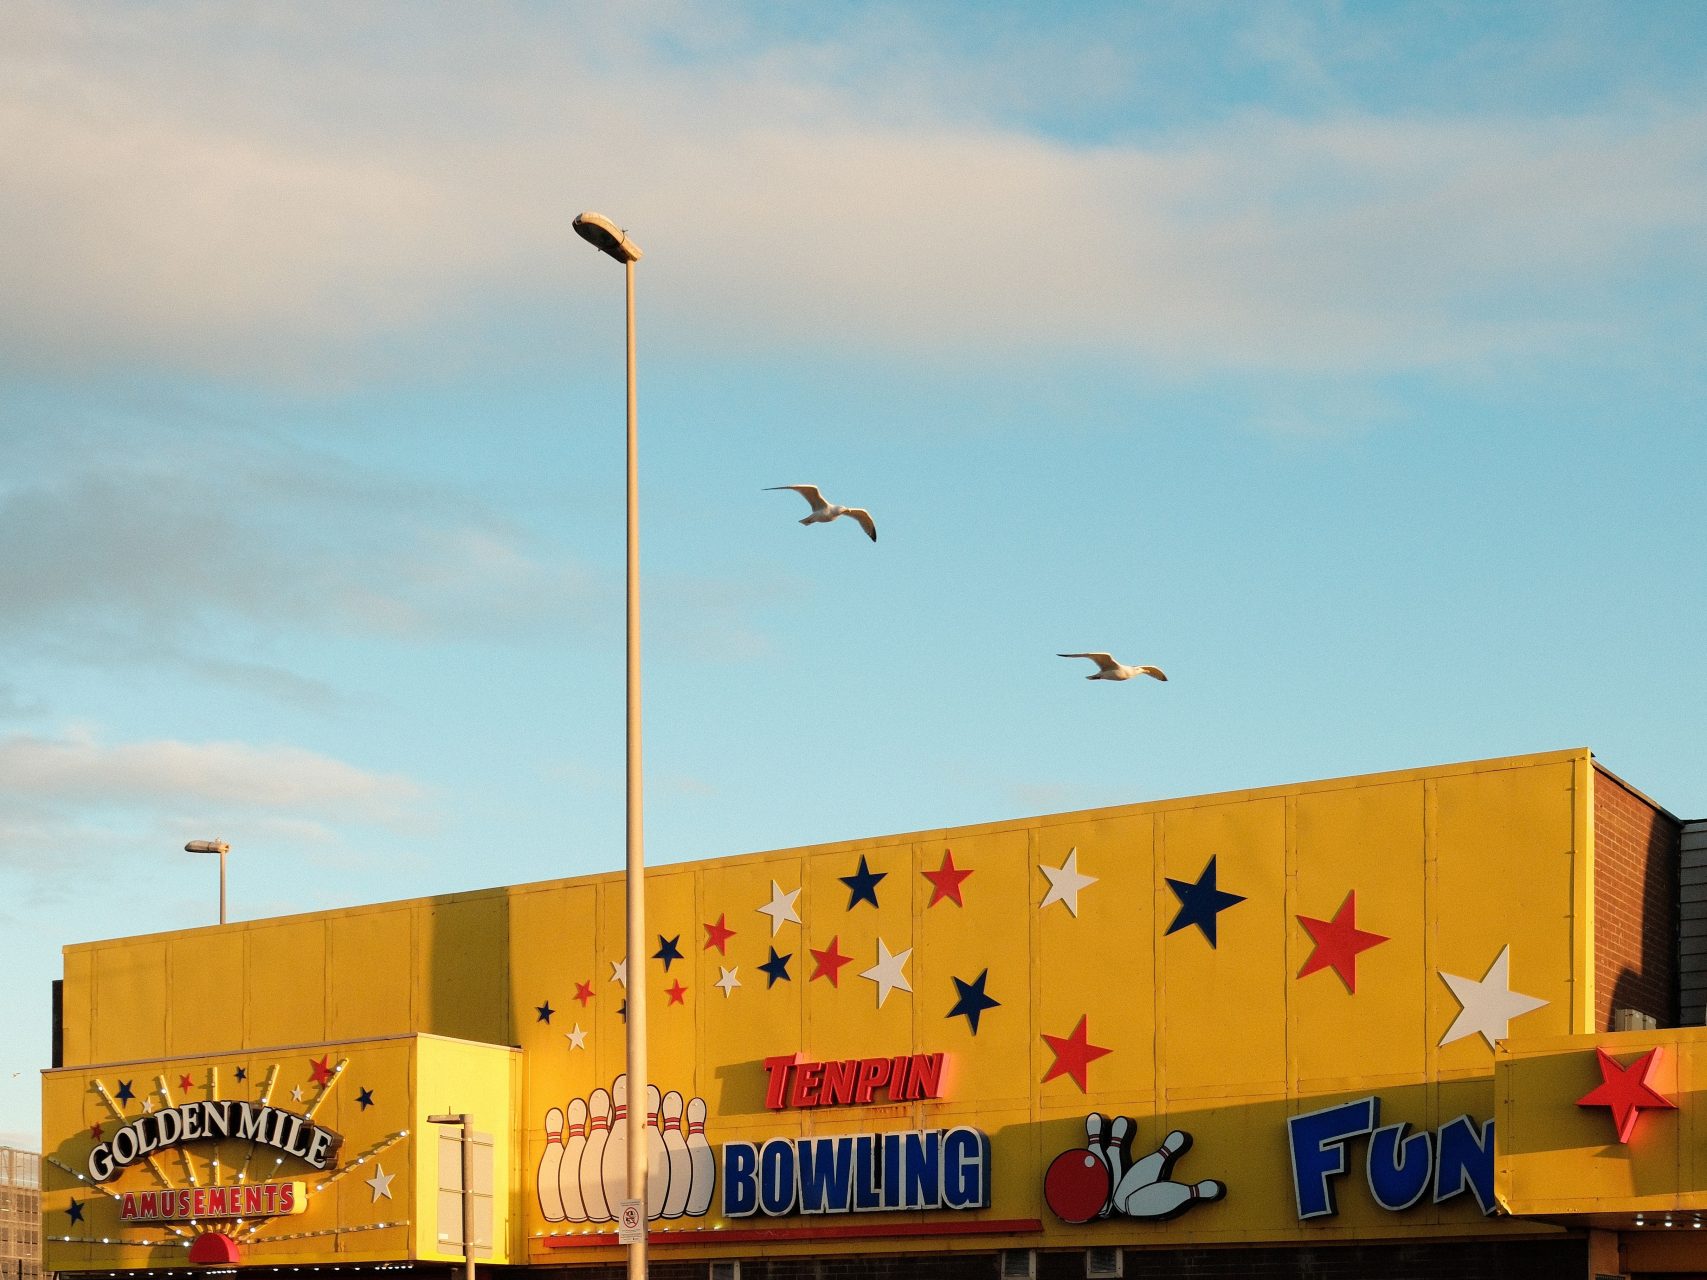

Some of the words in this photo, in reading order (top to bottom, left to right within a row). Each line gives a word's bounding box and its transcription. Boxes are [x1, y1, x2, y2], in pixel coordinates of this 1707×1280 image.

[764, 1053, 944, 1109] TENPIN
[87, 1100, 232, 1182] GOLDEN
[235, 1101, 333, 1170] MILE
[722, 1125, 984, 1217] BOWLING
[1287, 1096, 1496, 1220] FUN
[120, 1183, 295, 1220] AMUSEMENTS
